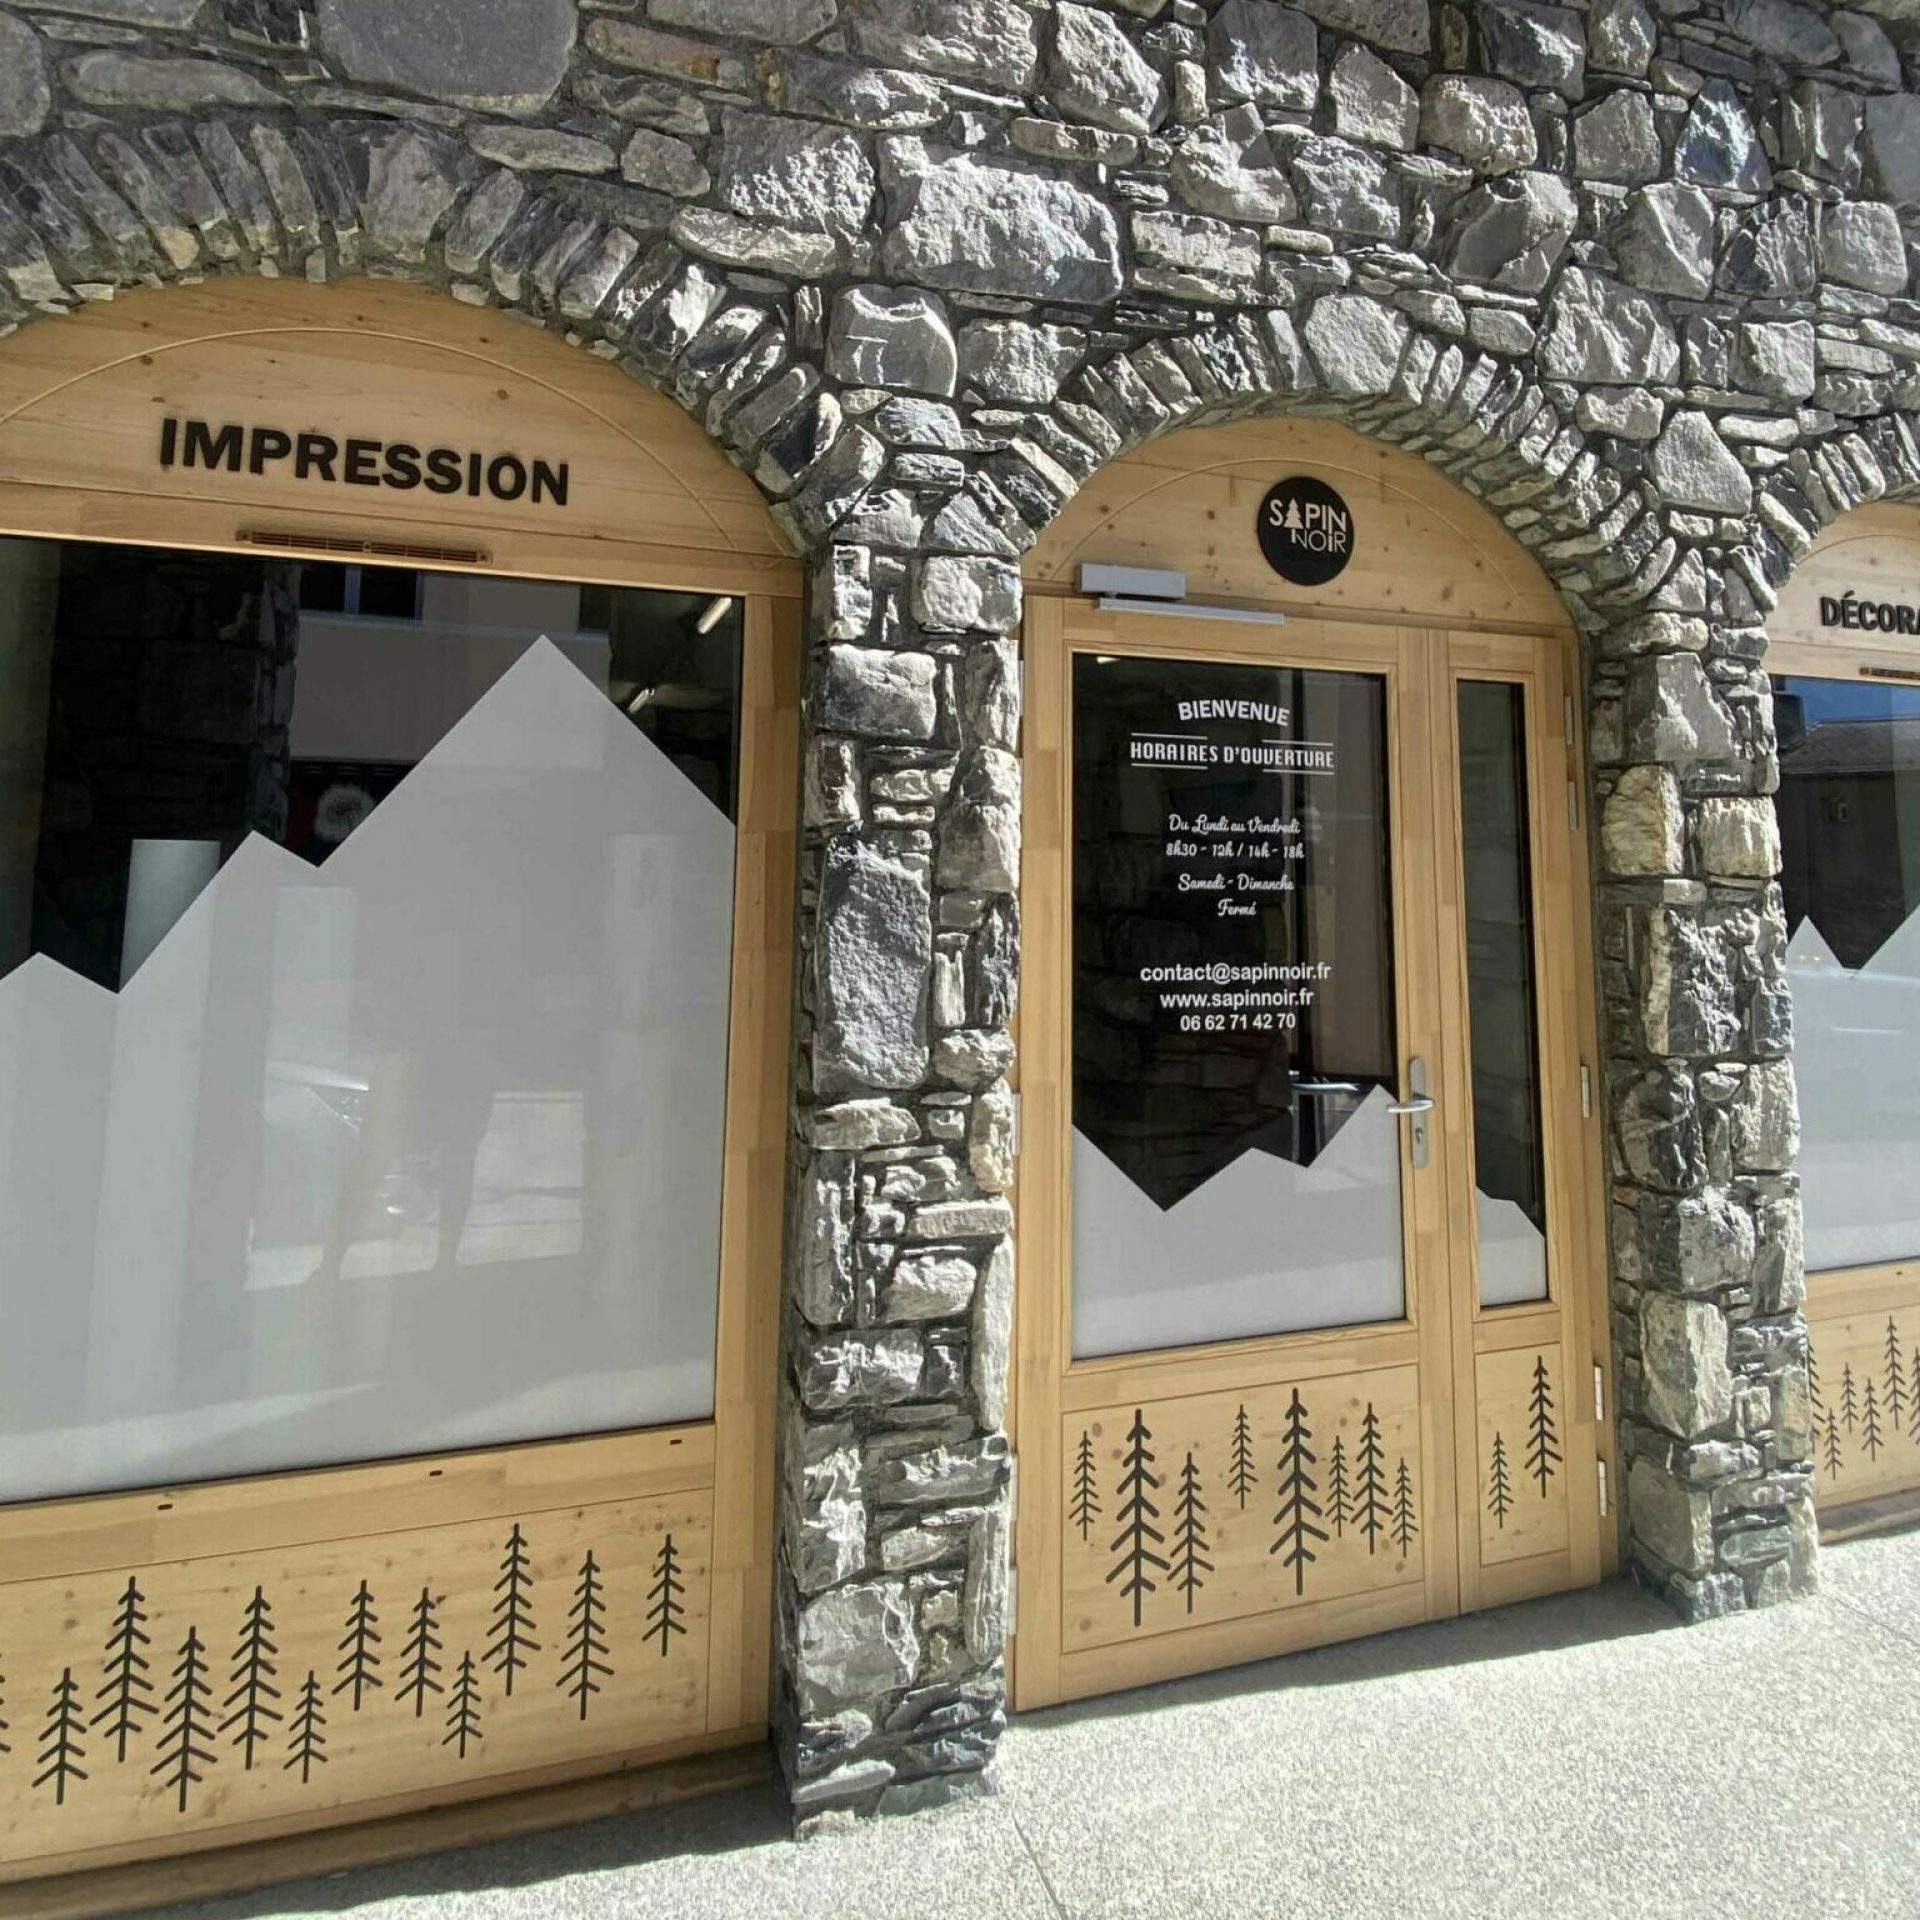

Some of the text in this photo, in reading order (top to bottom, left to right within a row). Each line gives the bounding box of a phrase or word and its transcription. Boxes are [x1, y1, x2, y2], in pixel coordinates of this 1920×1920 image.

[160, 418, 570, 506] IMPRESSION
[1290, 529, 1347, 553] NOIR
[1820, 590, 1920, 635] DÉCOR
[1178, 700, 1290, 727] BIENVENUE
[1131, 742, 1334, 768] HORAIRES D'OUVERTURE
[1169, 814, 1300, 835] Du Lundi au Vendredi
[1166, 841, 1197, 856] 8h30
[1212, 843, 1234, 857] 12h
[1249, 843, 1270, 858] 14h
[1284, 843, 1305, 858] 18h
[1178, 874, 1225, 891] Samedi
[1237, 874, 1294, 891] Dimanche
[1217, 899, 1256, 916] Fermé
[1140, 962, 1331, 984] contact@sapinnoir.fr
[1160, 988, 1314, 1010] www.sapinnoir.fr
[1180, 1013, 1296, 1031] 06 62 71 42 70
